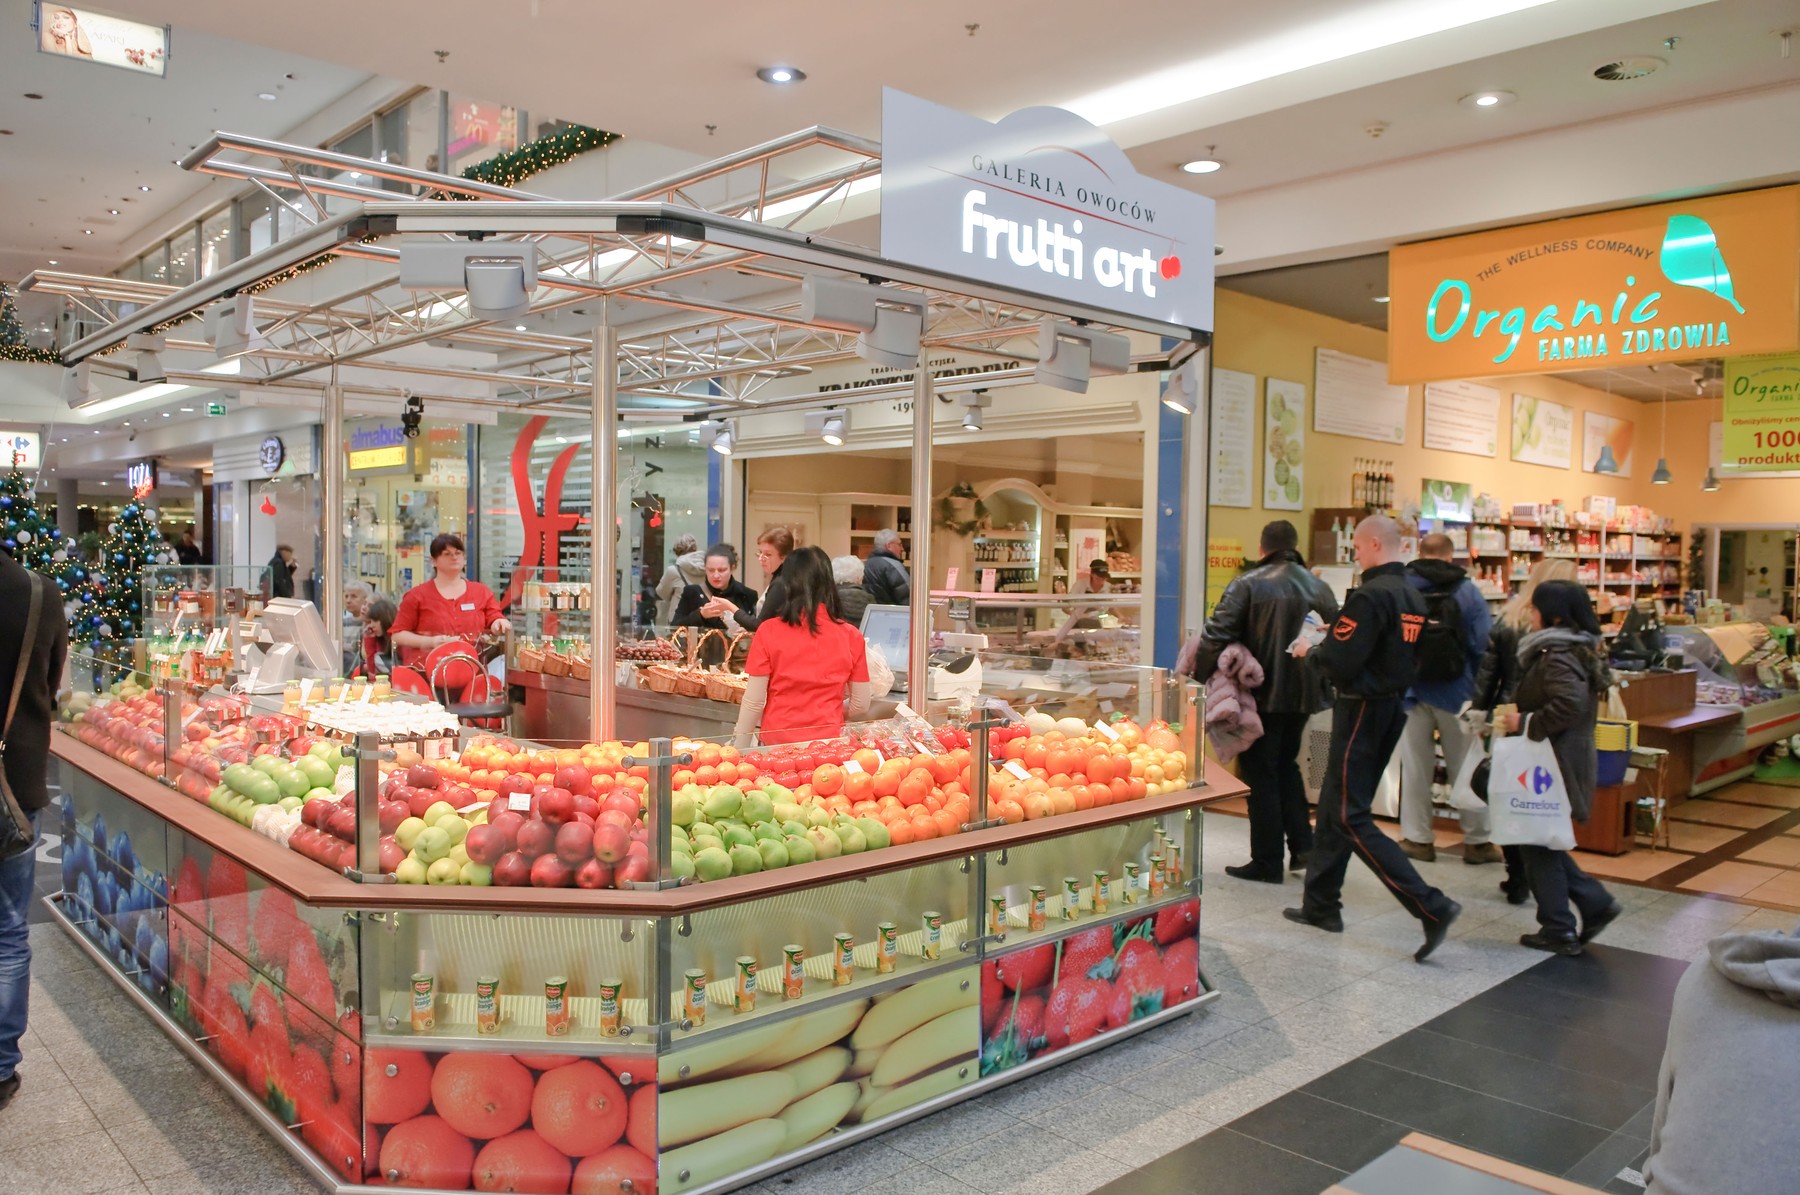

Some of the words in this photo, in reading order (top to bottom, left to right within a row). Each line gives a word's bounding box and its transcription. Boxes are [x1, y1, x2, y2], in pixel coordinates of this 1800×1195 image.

[971, 154, 1067, 198] GALERIA
[1076, 187, 1157, 225] OWOCÓW
[961, 188, 1085, 281] frutti
[1093, 245, 1158, 299] art
[1475, 262, 1503, 283] THE
[1506, 239, 1580, 267] WELLNESS
[1585, 238, 1655, 261] COMPANY
[1426, 275, 1662, 364] Organic
[1538, 333, 1609, 362] FARMA
[1621, 321, 1731, 355] ZDROWIA
[1733, 375, 1800, 403] Organi
[351, 424, 405, 451] almabus
[1510, 797, 1561, 810] Carrefour
